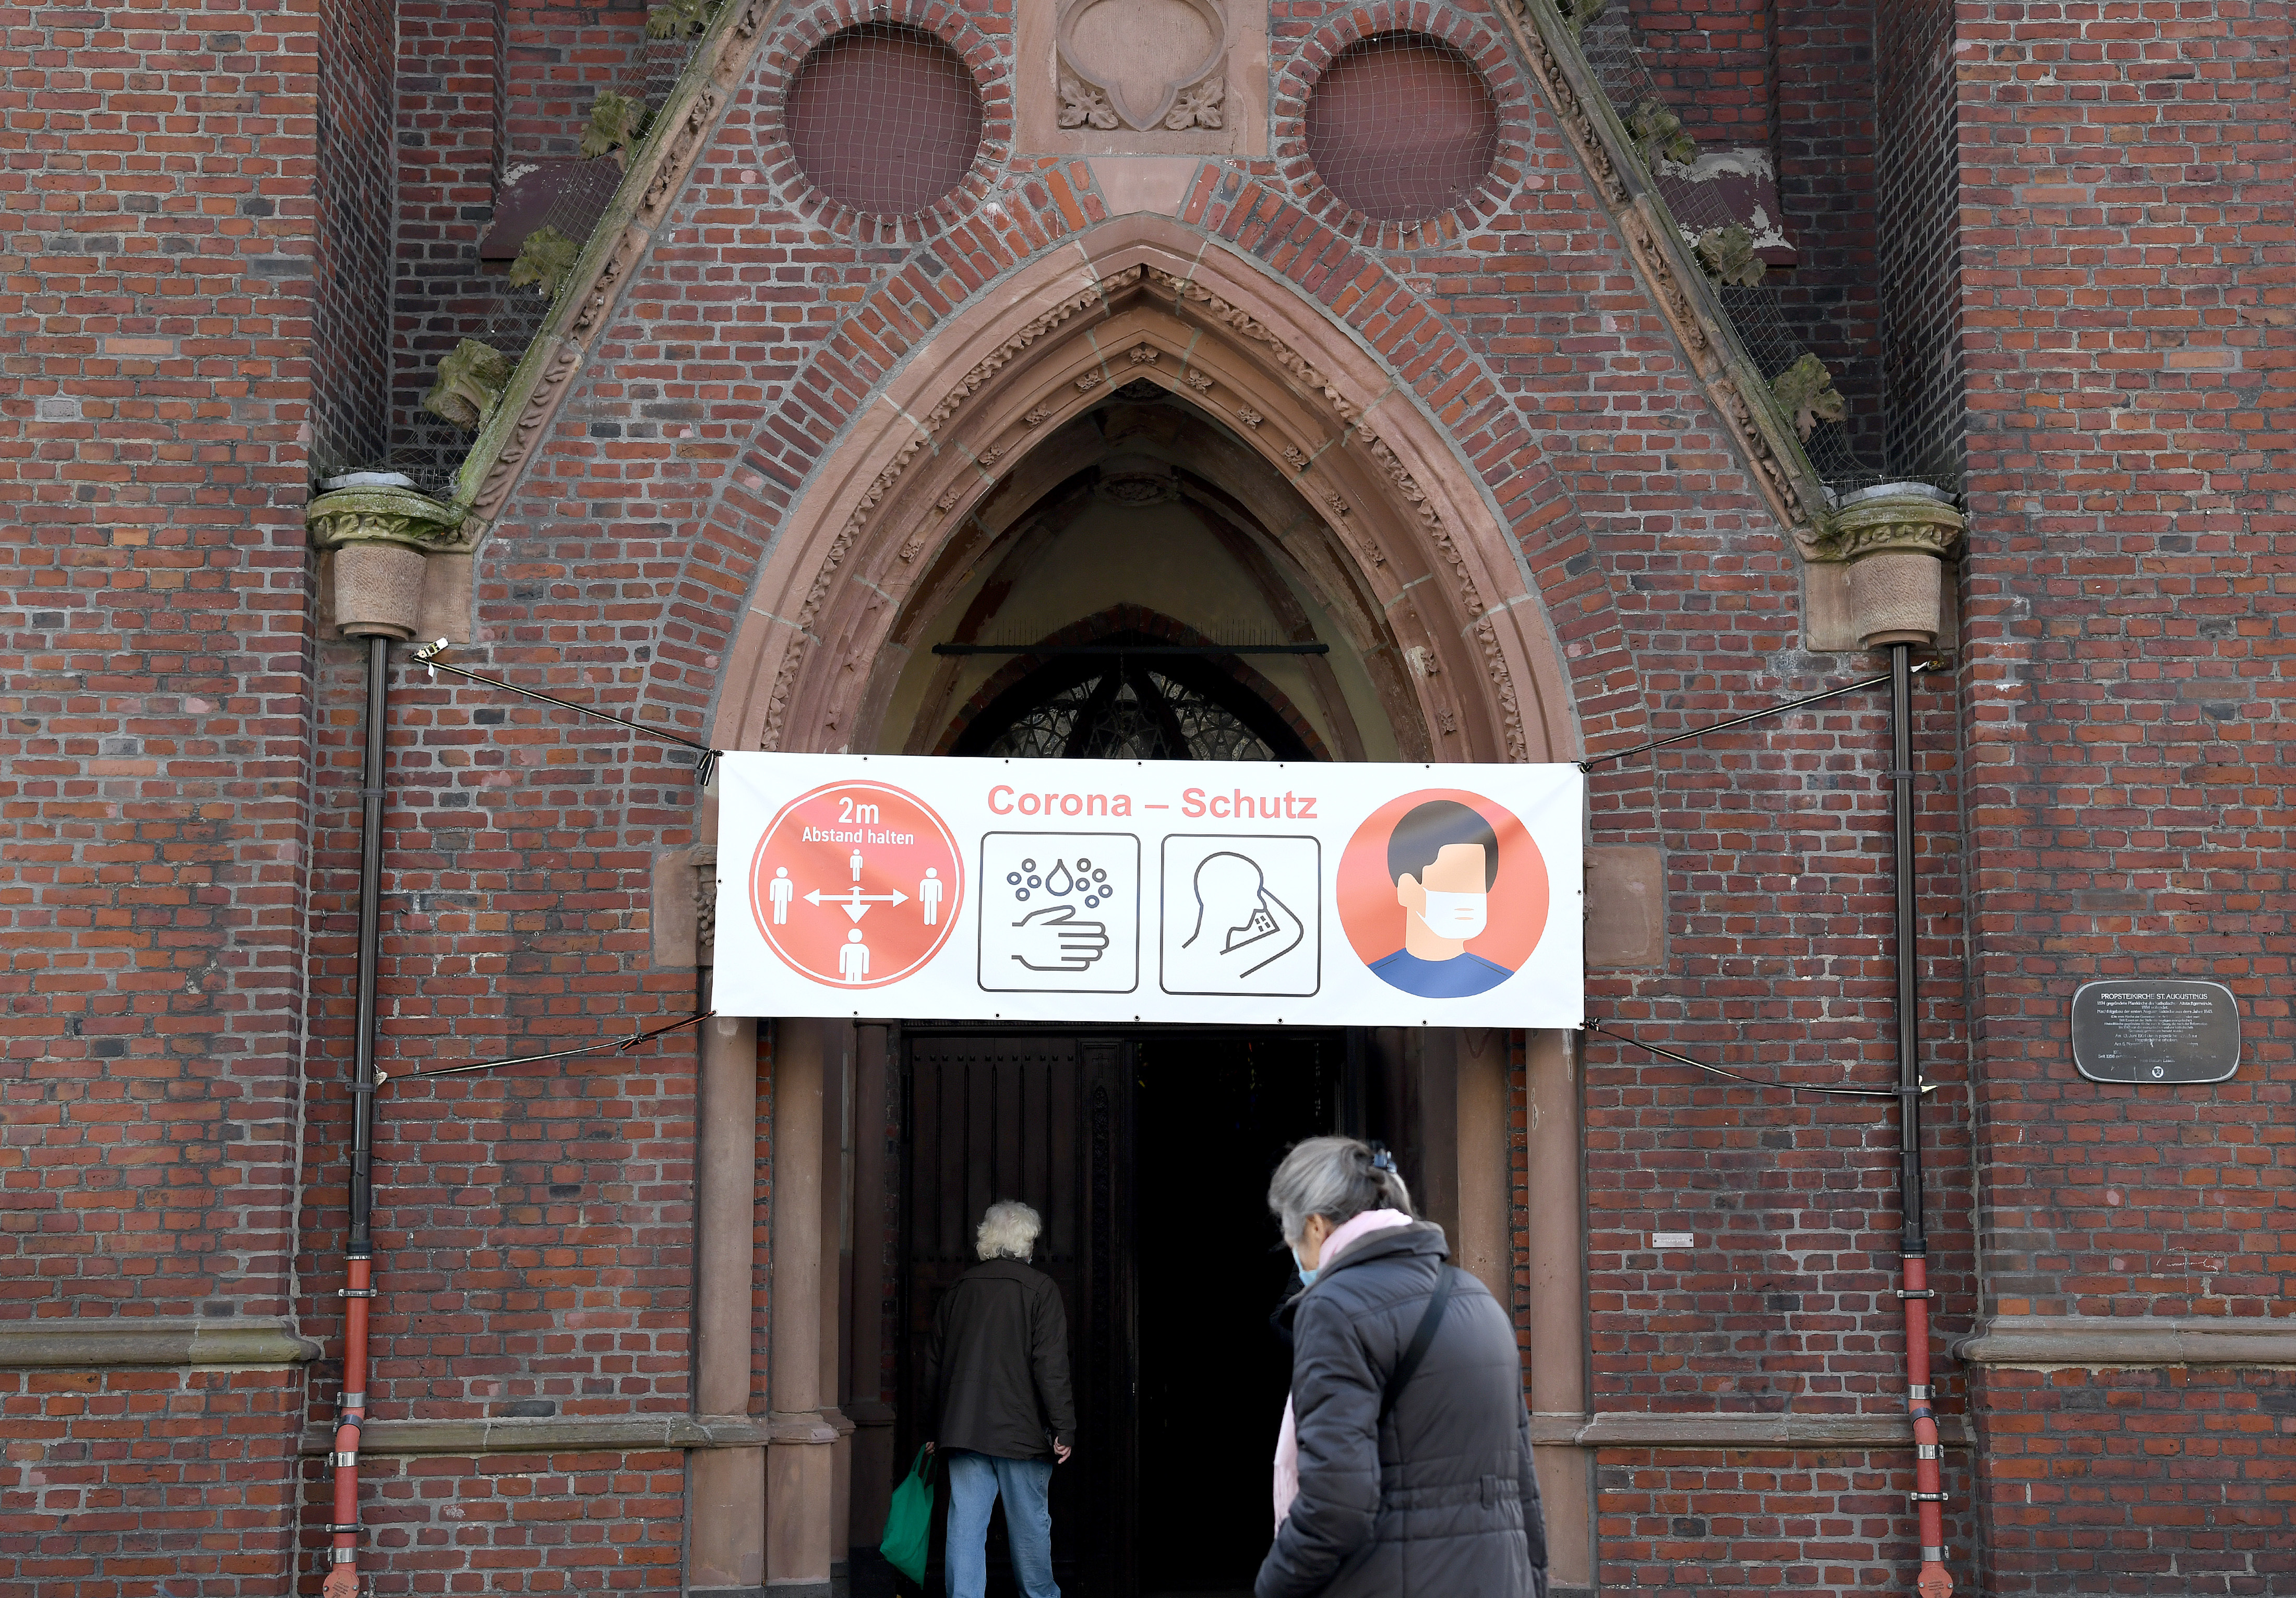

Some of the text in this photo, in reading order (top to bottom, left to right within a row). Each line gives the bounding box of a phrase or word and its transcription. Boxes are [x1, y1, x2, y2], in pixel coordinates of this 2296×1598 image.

[838, 797, 879, 824] 2m
[987, 784, 1132, 817] Corona
[1181, 787, 1318, 819] Schutz
[802, 826, 914, 845] Abstand halten
